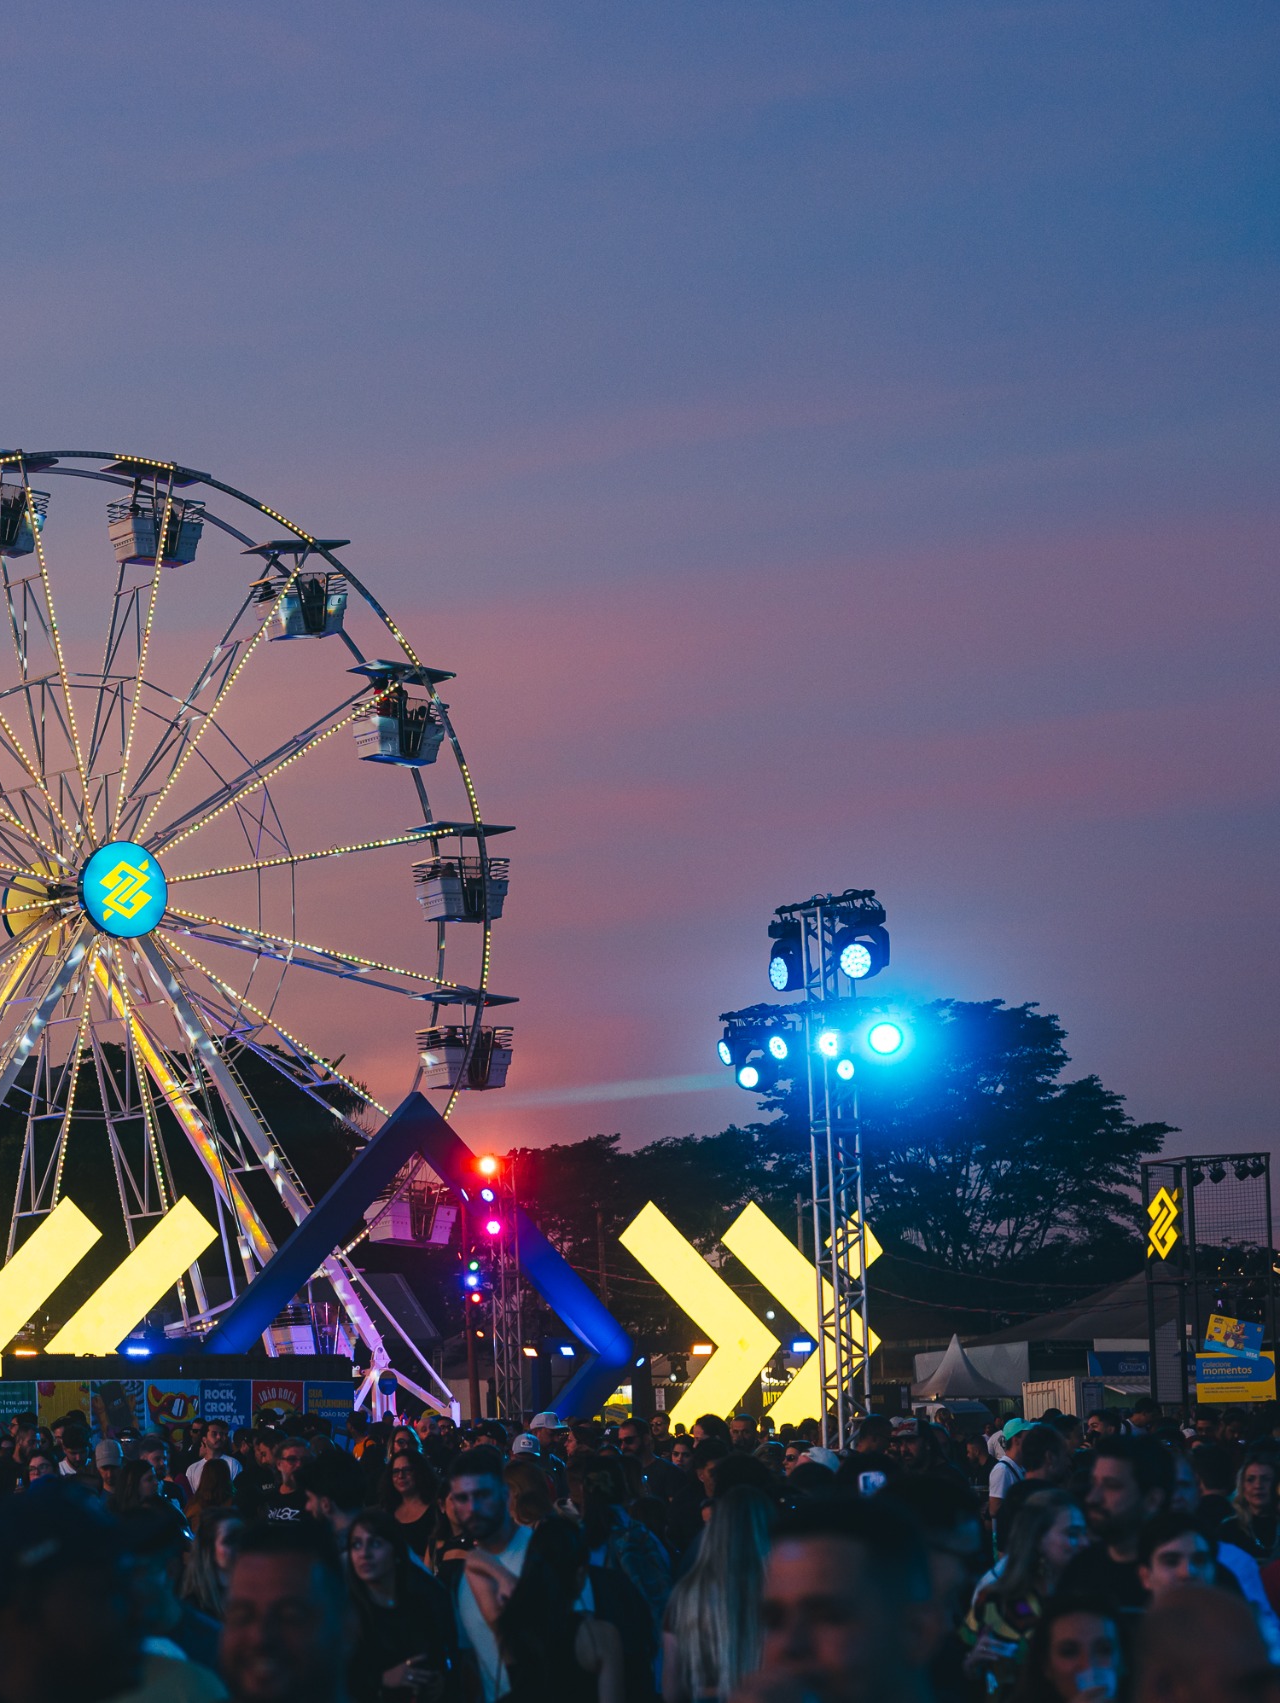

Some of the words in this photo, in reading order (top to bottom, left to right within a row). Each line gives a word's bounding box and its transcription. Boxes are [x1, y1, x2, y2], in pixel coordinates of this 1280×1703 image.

[1202, 1366, 1252, 1375] momentos
[204, 1389, 237, 1401] ROCK,
[258, 1386, 277, 1404] JOÃO
[278, 1386, 298, 1405] ROCK
[204, 1402, 237, 1414] CROK,
